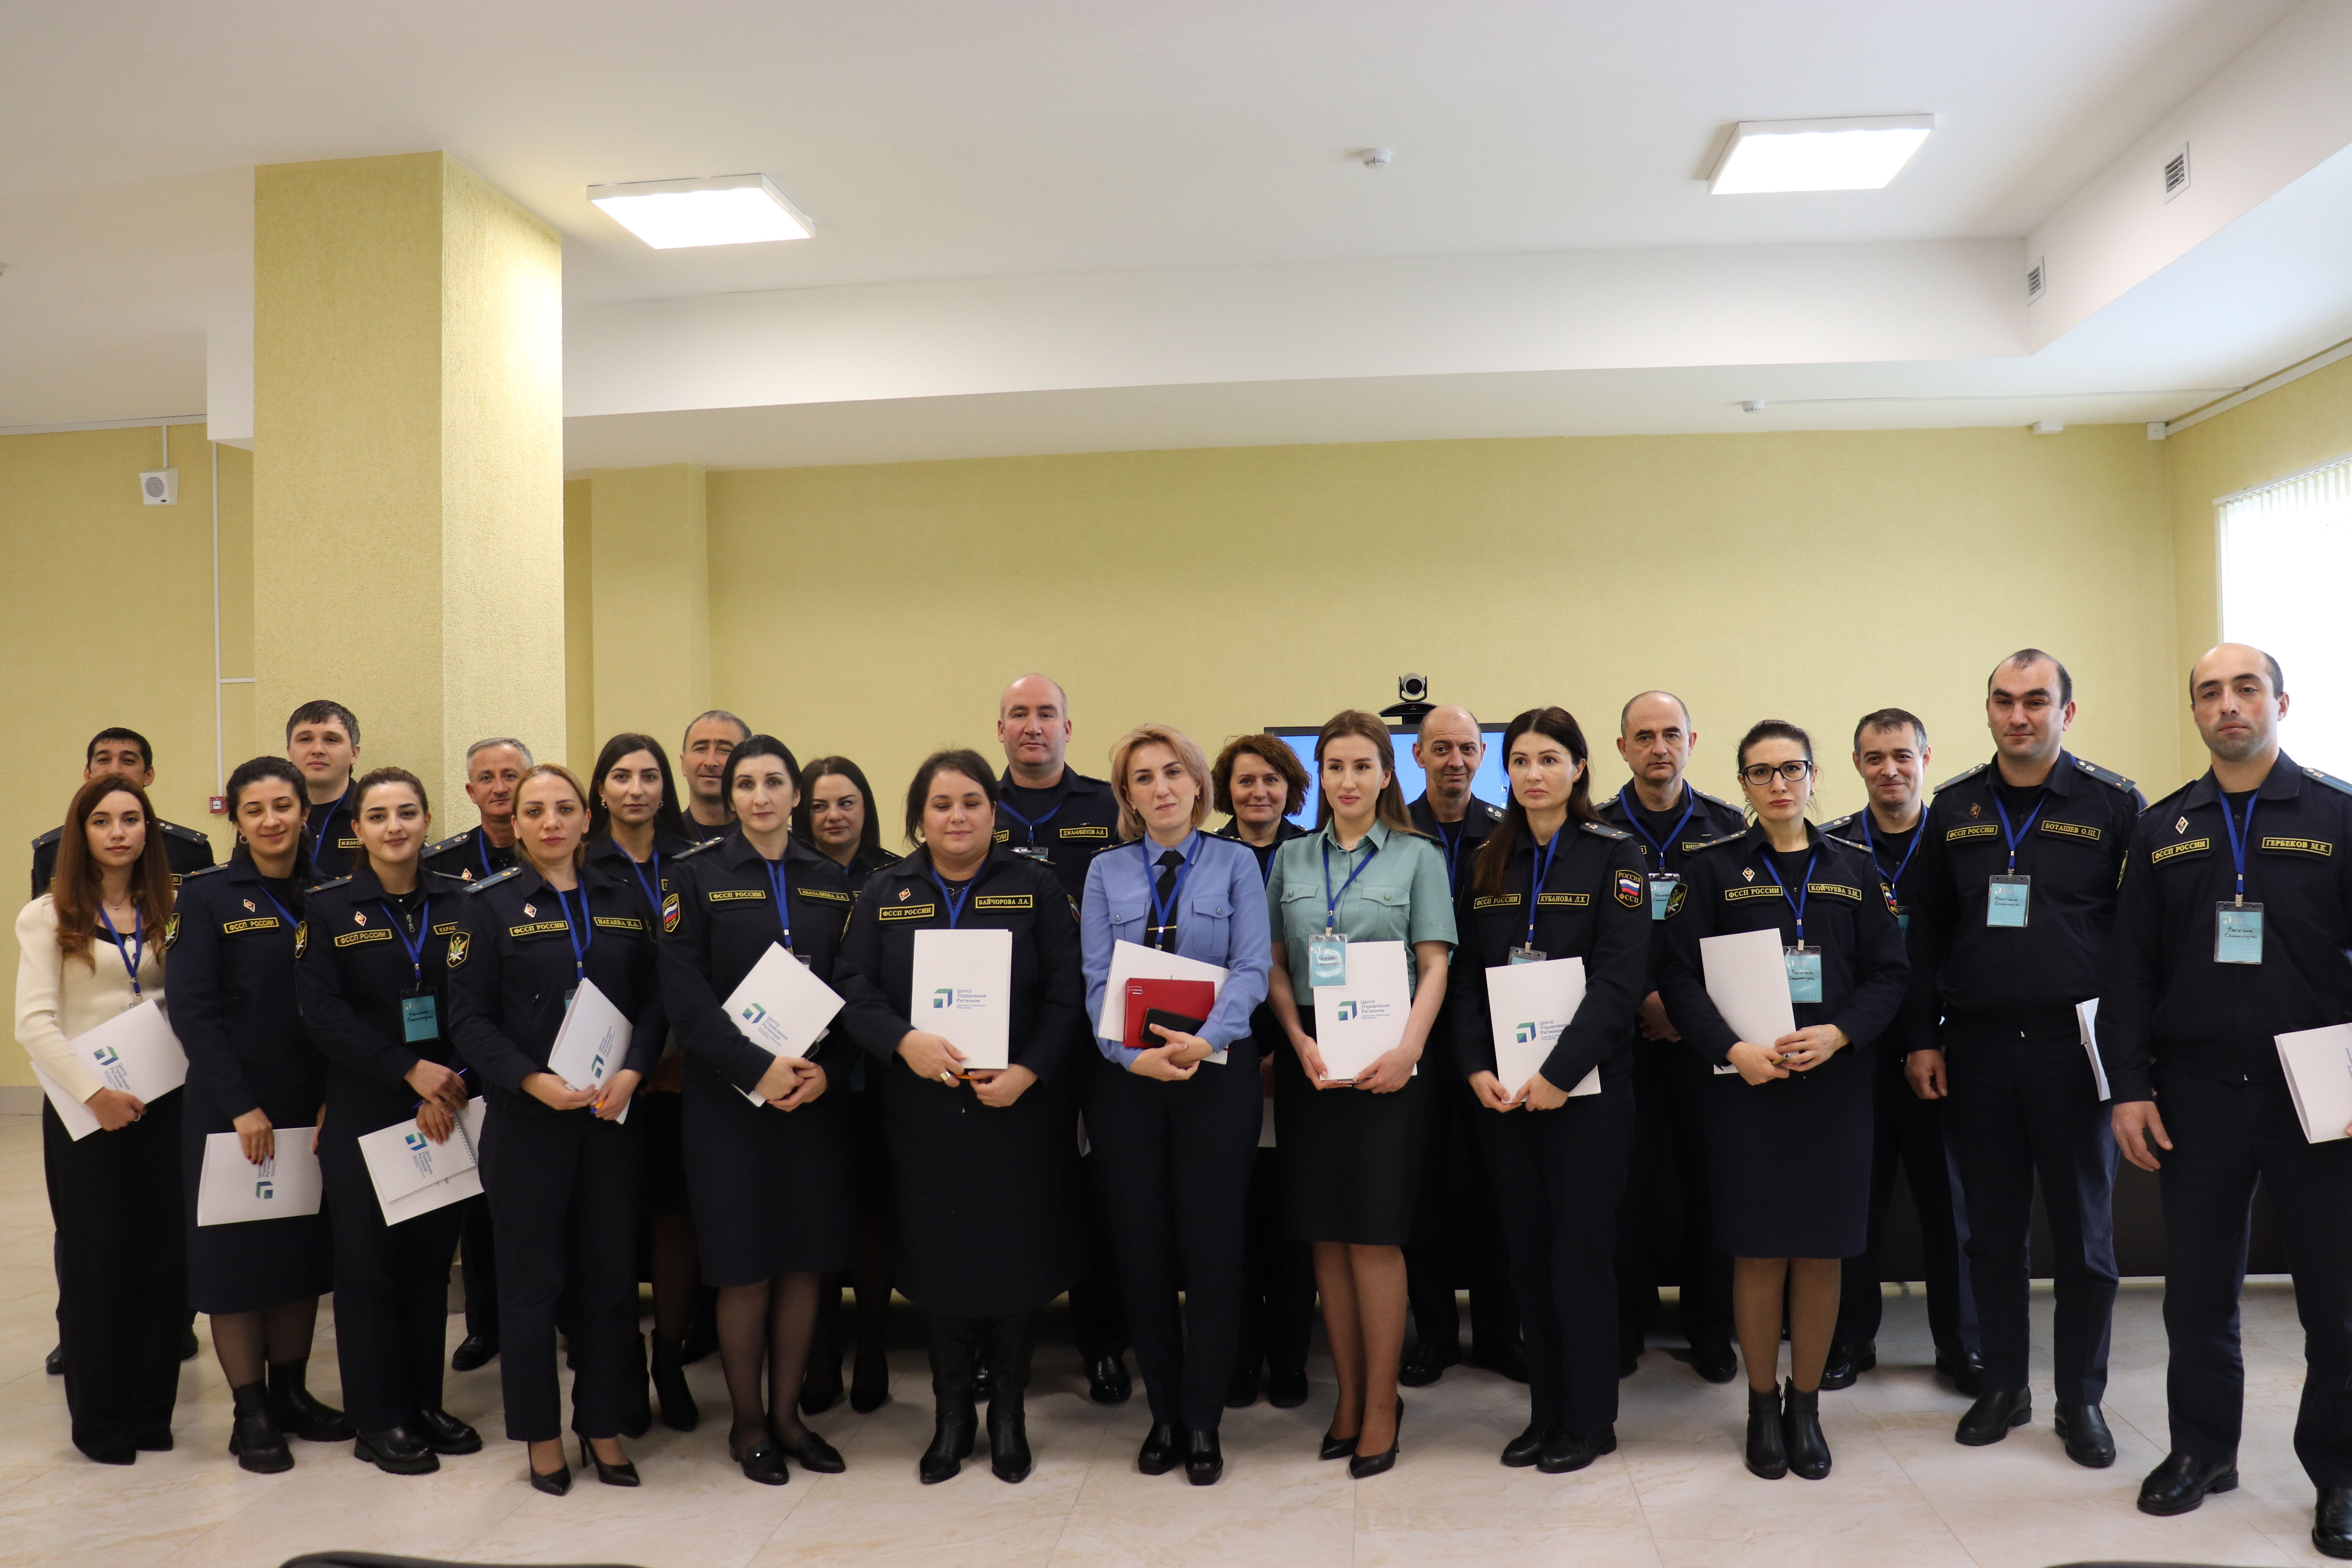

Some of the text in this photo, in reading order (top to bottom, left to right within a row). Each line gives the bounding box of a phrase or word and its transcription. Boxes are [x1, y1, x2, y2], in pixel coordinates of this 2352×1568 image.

[2045, 823, 2097, 837] БОТАШЕВ О.Ш.
[2155, 841, 2206, 859] ФССП РОССИИ
[2266, 840, 2328, 852] ГЕРБЕКОВ М.К.
[1618, 872, 1641, 883] РОССИЯ
[1811, 885, 1846, 893] КОЙЧУЕВА
[663, 897, 677, 909] РОССИЯ
[1619, 893, 1639, 903] ФССП
[904, 907, 931, 916] РОССИИ
[229, 922, 248, 931] ФССП
[537, 922, 565, 931] РОССИИ
[666, 918, 677, 929] ФССП
[341, 931, 386, 944] ФССП РОССИИ
[768, 1015, 780, 1027] Центр
[762, 1022, 781, 1040] Регионом
[765, 1019, 788, 1041] Управления
[118, 1063, 127, 1076] Центр
[110, 1067, 123, 1088] Регионом
[114, 1065, 130, 1090] Управления
[418, 1153, 428, 1172] Регионом
[422, 1151, 433, 1174] Управления
